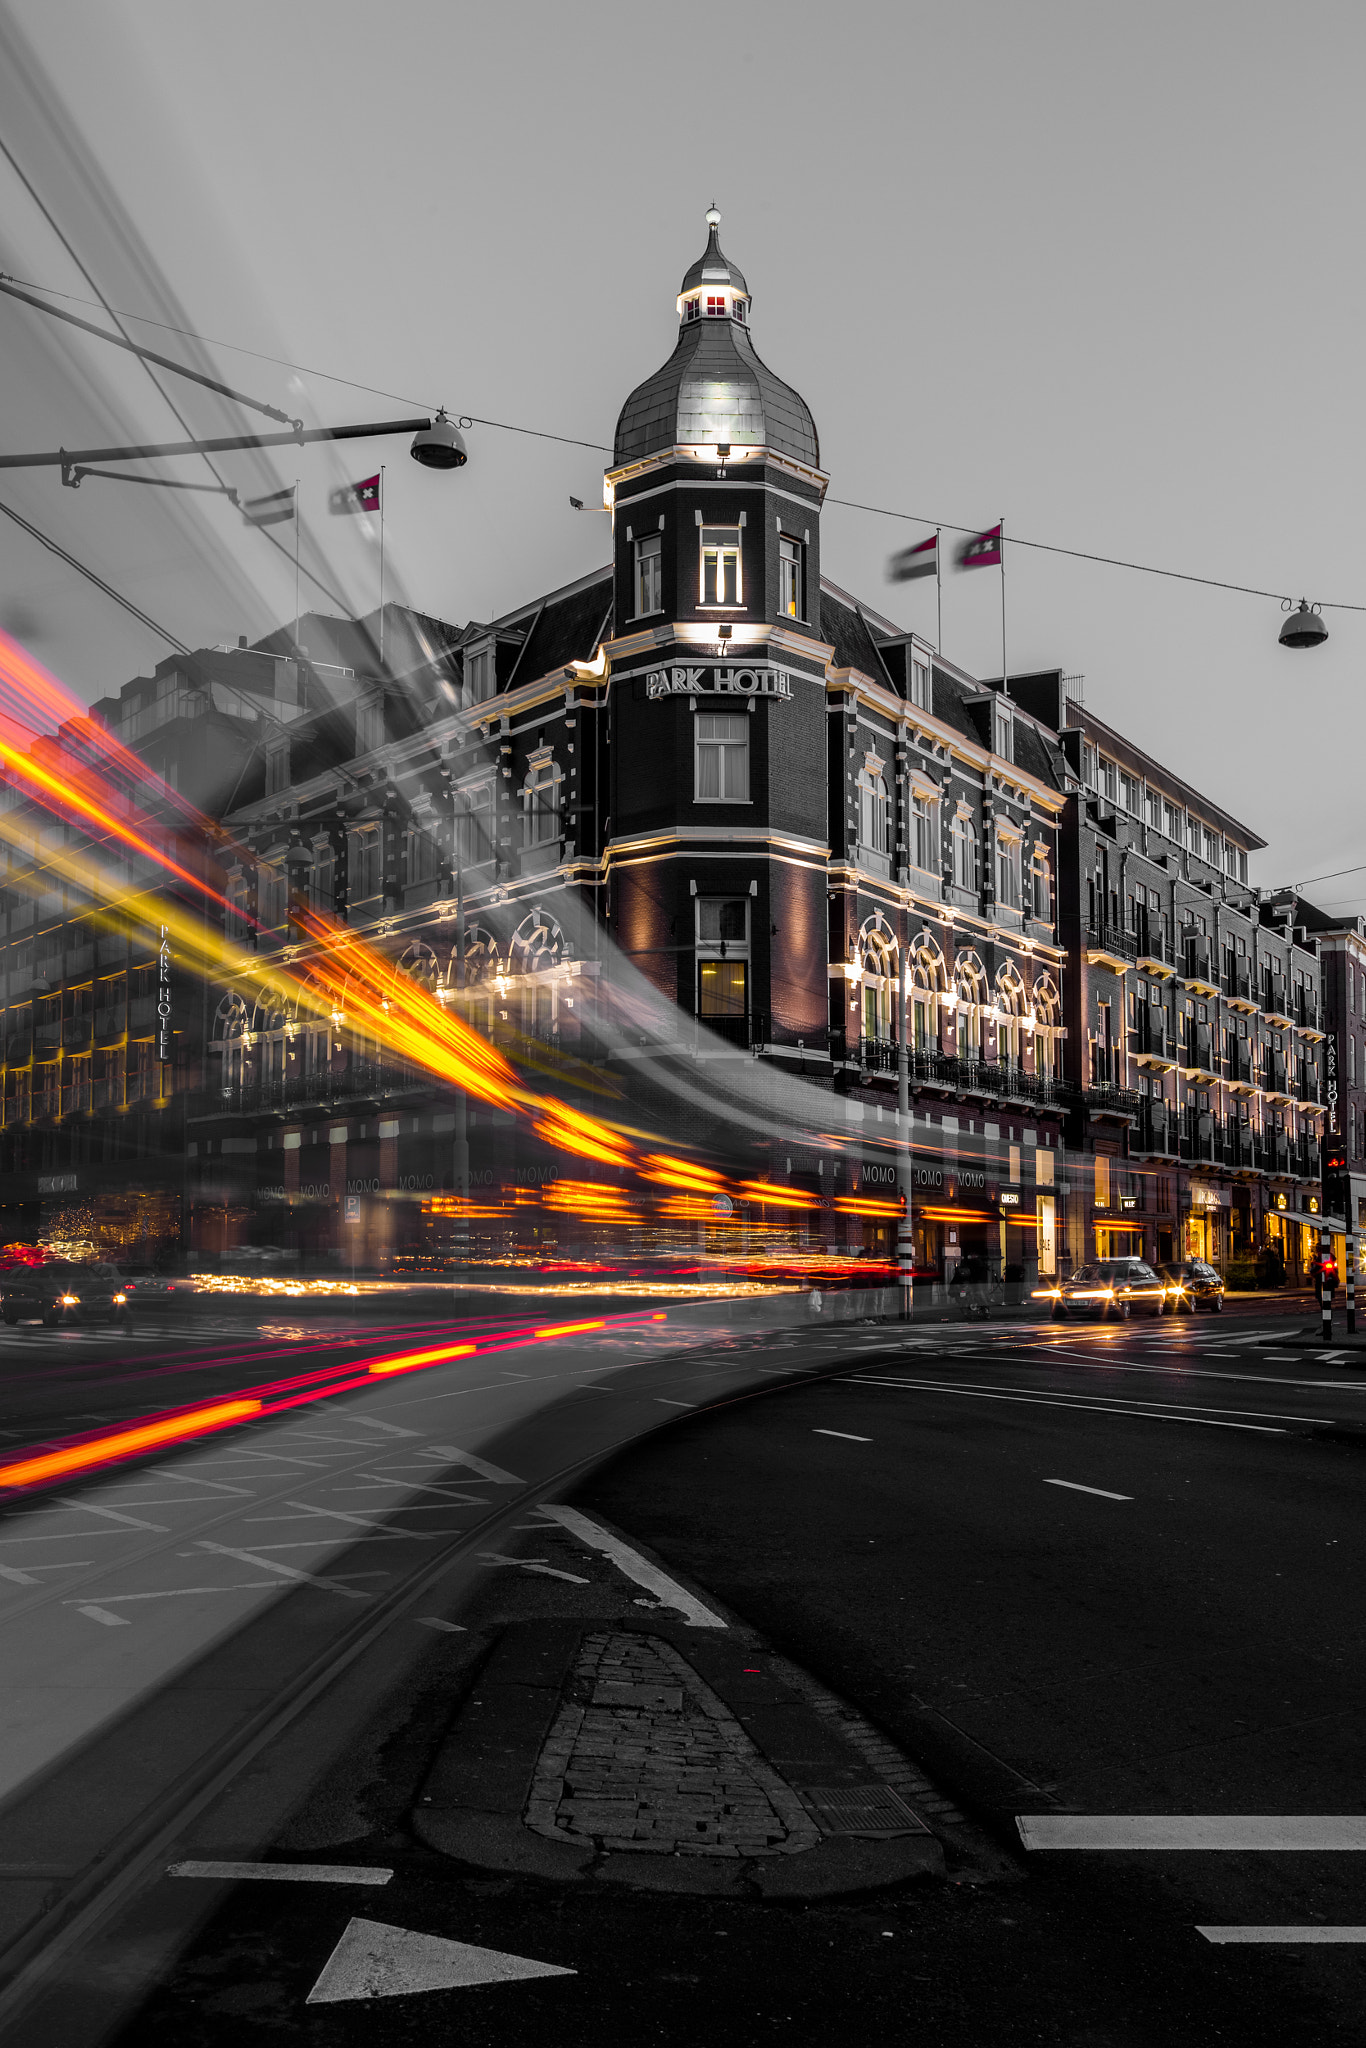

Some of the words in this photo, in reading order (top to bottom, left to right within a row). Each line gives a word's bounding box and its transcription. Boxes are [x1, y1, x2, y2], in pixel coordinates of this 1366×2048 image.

[646, 667, 706, 699] PARK
[714, 668, 794, 700] HOTEL
[160, 924, 171, 982] PARK
[158, 987, 171, 1060] HOTEL
[1327, 1034, 1336, 1077] PARK
[1327, 1080, 1338, 1133] HOTEL
[400, 1174, 434, 1191] MOMO
[467, 1169, 493, 1185] OMO
[516, 1165, 559, 1183] MOMO
[862, 1165, 895, 1183] MOMO
[957, 1172, 985, 1188] MOMO
[256, 1185, 285, 1200] MOMO
[301, 1183, 330, 1199] MOMO
[347, 1178, 380, 1194] MOMO
[347, 1198, 356, 1209] P
